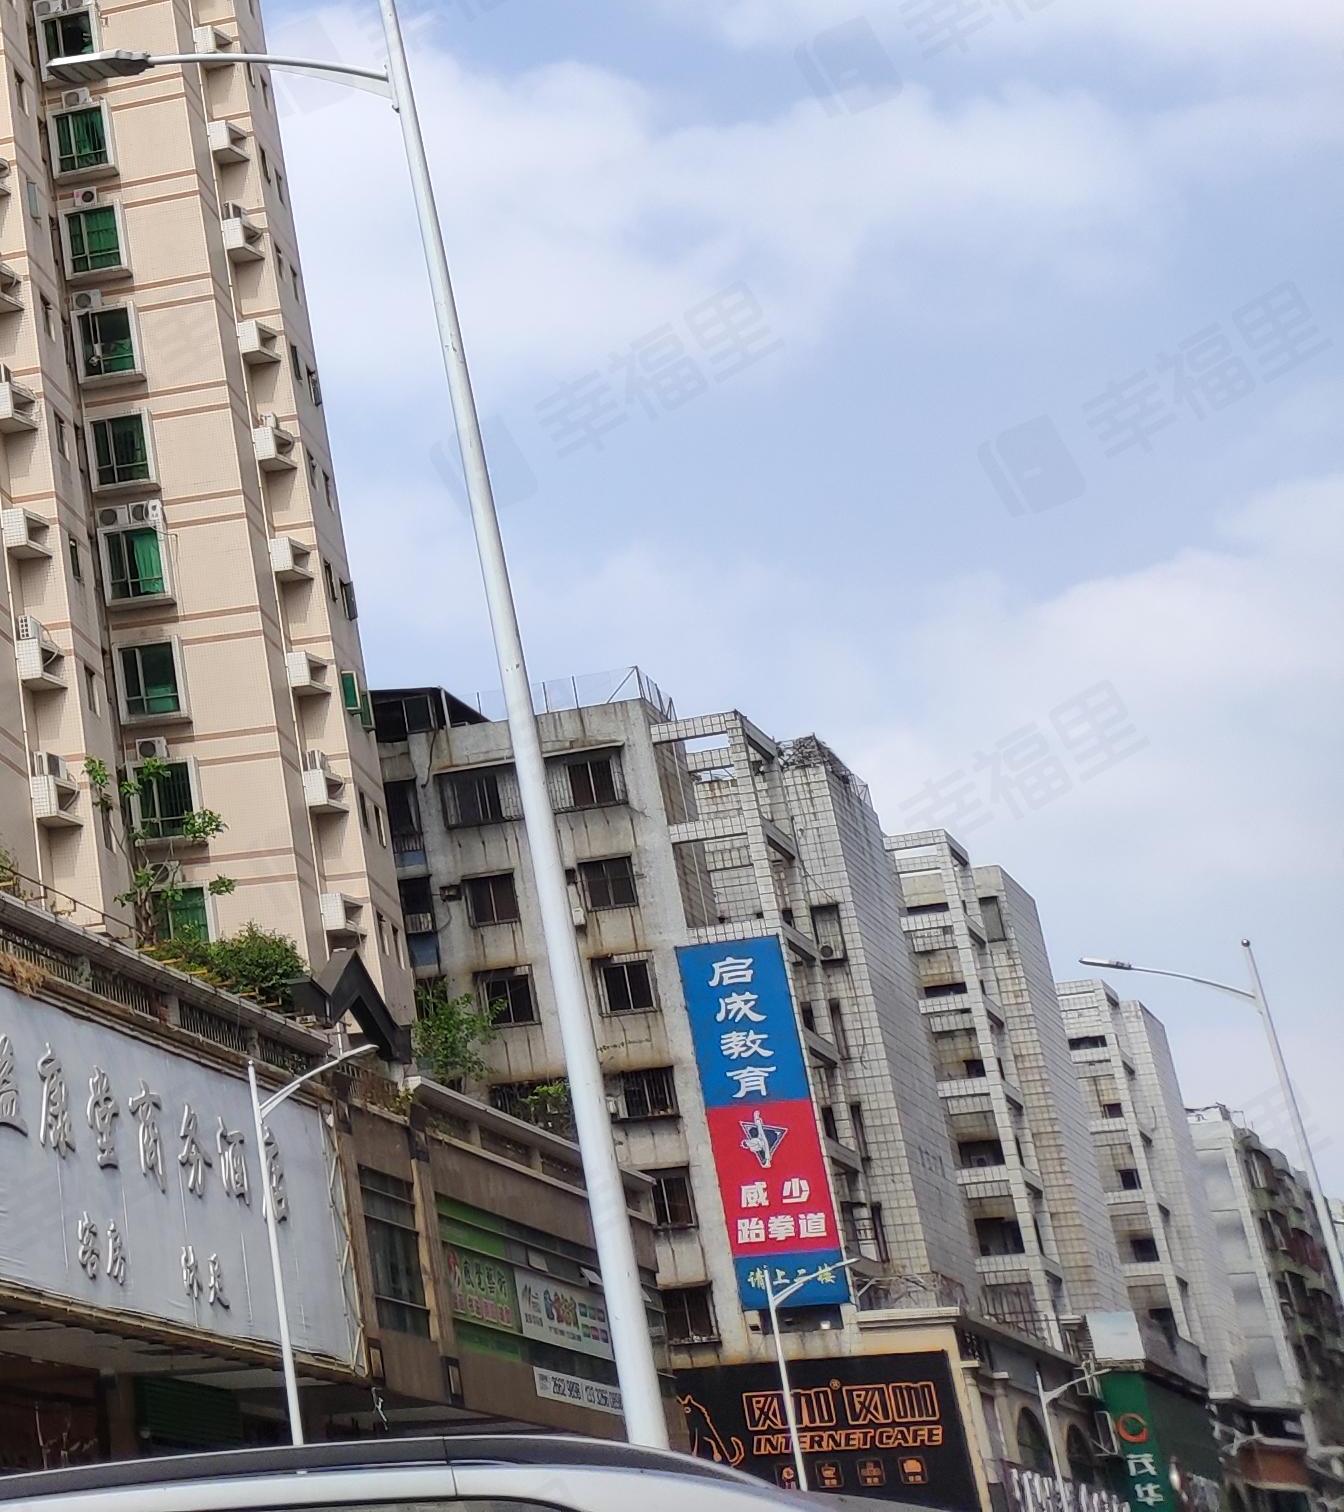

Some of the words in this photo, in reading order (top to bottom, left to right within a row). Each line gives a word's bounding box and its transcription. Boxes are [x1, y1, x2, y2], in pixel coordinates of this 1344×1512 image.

[708, 956, 777, 1099] 启成教育
[741, 1178, 810, 1208] 威少
[737, 1213, 827, 1243] 跆拳道
[753, 1429, 874, 1455] INTERNET
[875, 1425, 943, 1448] CAFE
